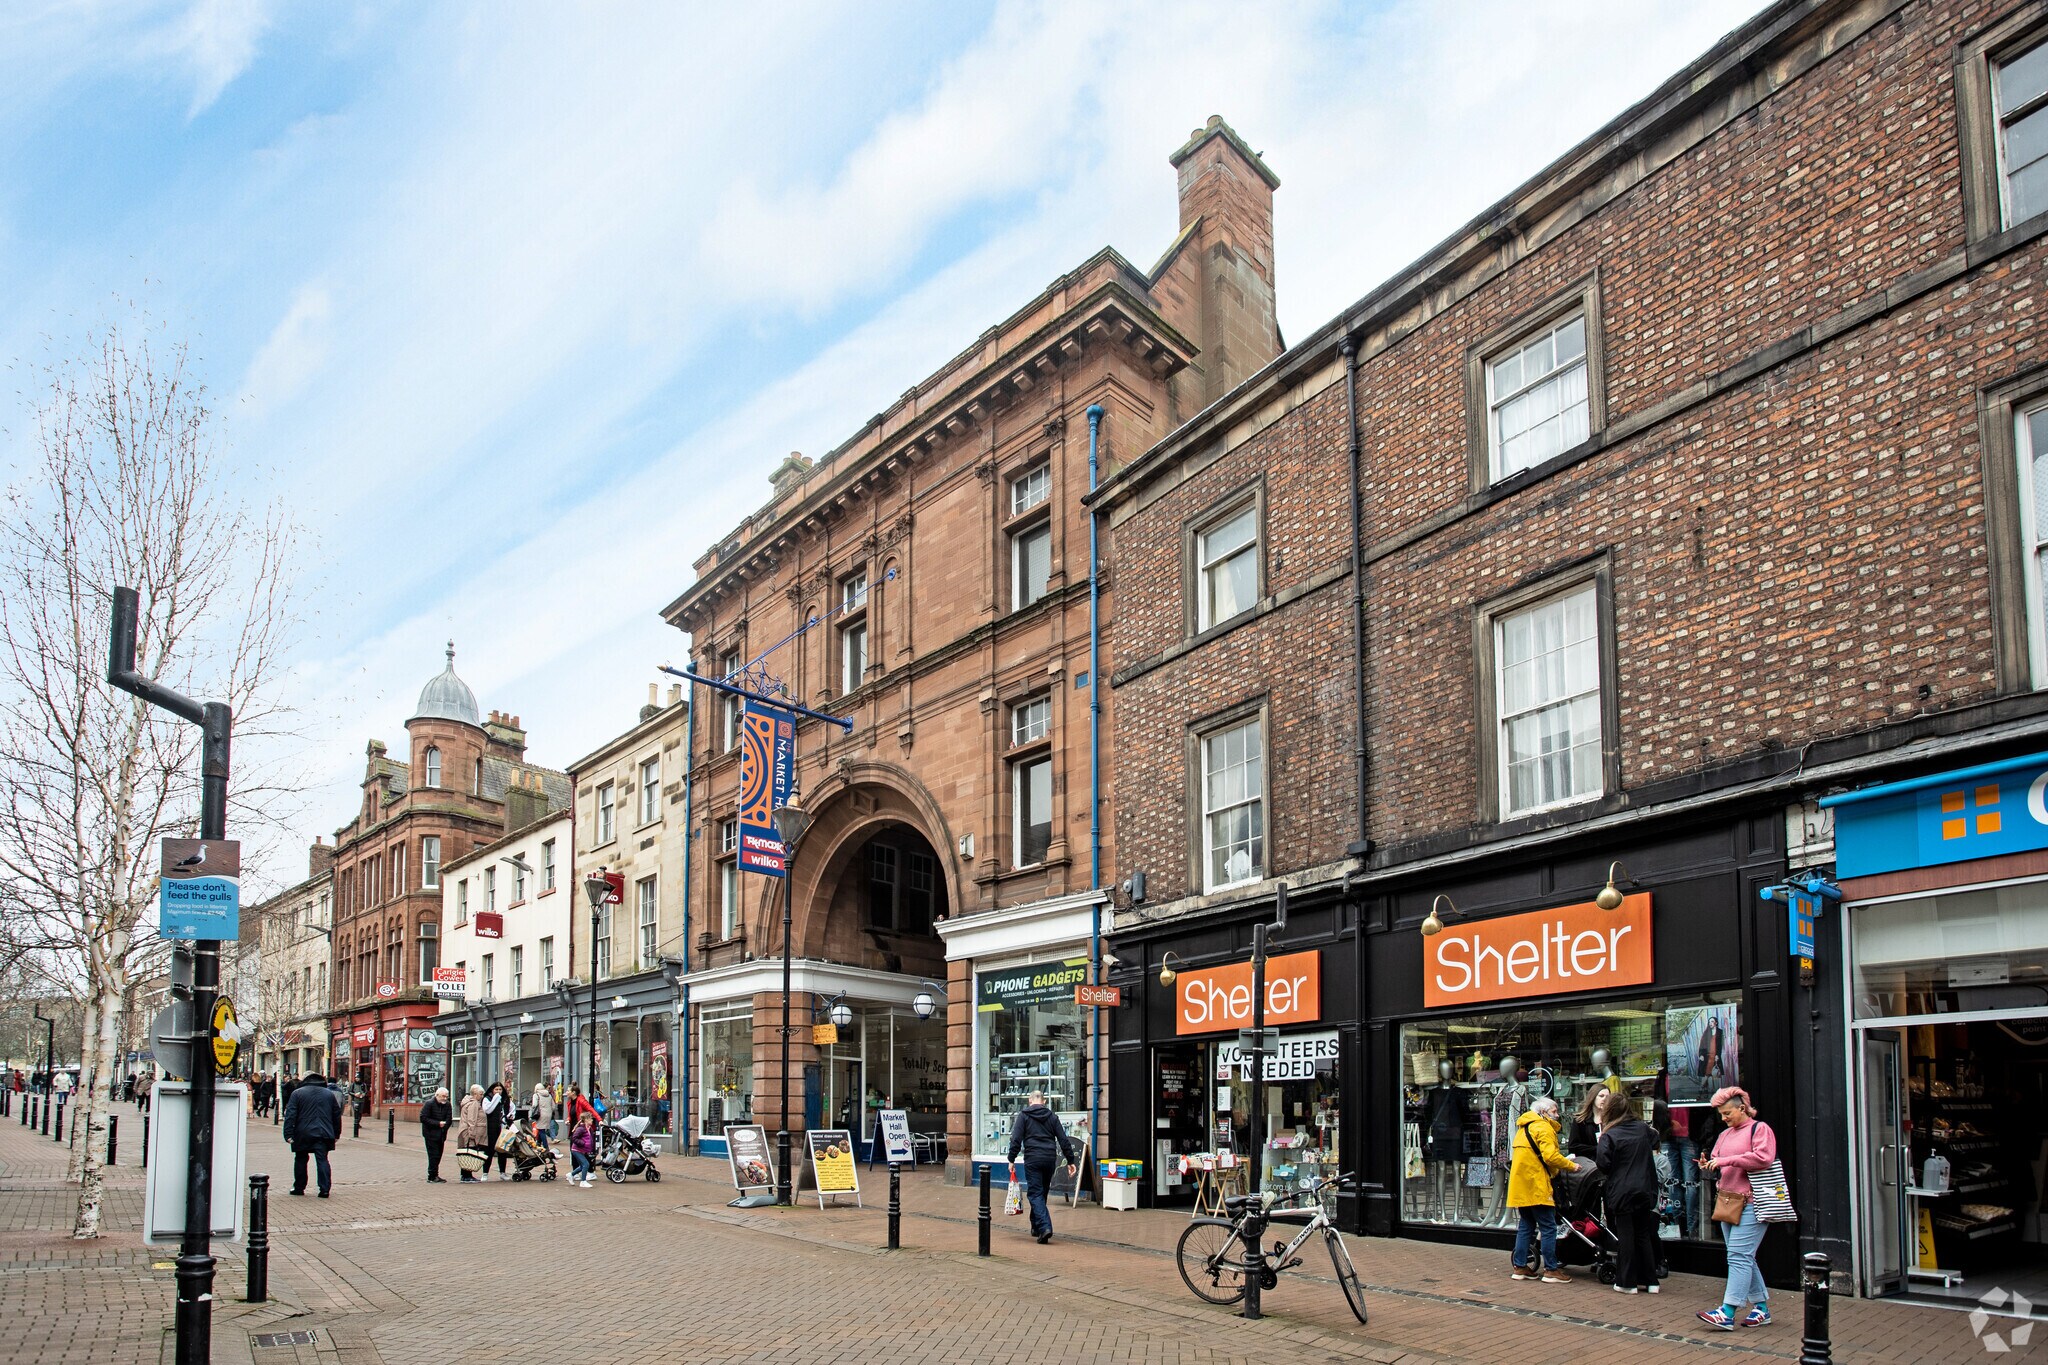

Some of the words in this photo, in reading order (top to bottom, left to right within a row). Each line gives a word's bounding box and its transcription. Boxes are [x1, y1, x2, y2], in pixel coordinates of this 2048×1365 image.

[775, 738, 787, 793] MARKET
[751, 855, 779, 868] wilko
[168, 881, 200, 891] Please
[202, 883, 226, 892] don't
[167, 891, 189, 900] feed
[191, 892, 207, 900] the
[209, 893, 232, 902] gulls
[477, 927, 499, 937] wilko
[1437, 920, 1632, 992] Shelter
[993, 976, 1031, 993] PHONE
[1033, 968, 1085, 988] GADGETS
[451, 983, 466, 991] LET
[1001, 990, 1025, 998] ACCESSORIES
[1081, 987, 1117, 1003] Shelter
[2022, 1025, 2047, 1034] point
[903, 1056, 931, 1073] Totally
[1243, 1060, 1314, 1080] NEDED
[420, 1072, 436, 1080] STUFF
[888, 1132, 907, 1141] Open
